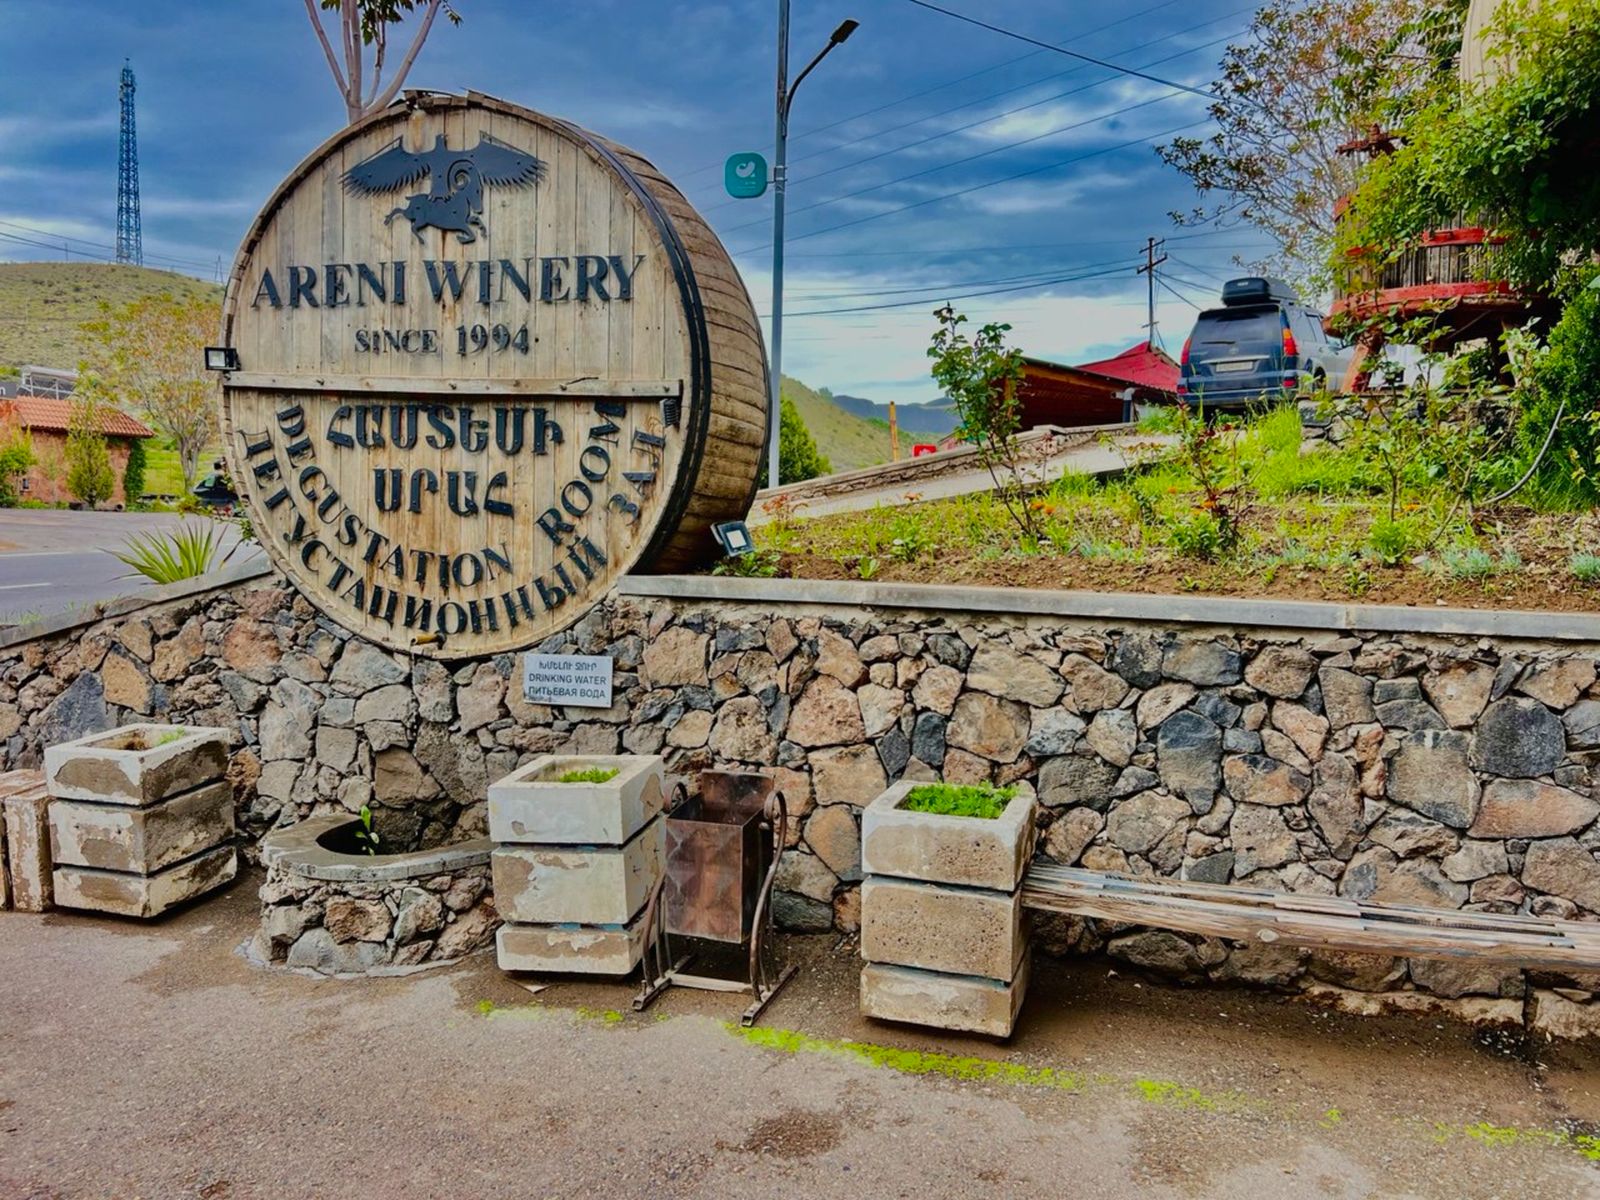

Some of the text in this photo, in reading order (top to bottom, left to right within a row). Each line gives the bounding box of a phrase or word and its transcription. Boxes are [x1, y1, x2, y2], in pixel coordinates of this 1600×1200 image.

[251, 254, 646, 309] ARENI WINERY
[354, 324, 529, 356] SINCE 1994
[326, 403, 564, 456] ՀԱՄՏԵՍԻ
[276, 400, 628, 588] DEGUSTATION ROOM
[373, 467, 515, 518] ՍՐԱՀ
[235, 424, 667, 635] ДЕГУСТАЦИОННЫЙ ЗАЛ
[528, 673, 607, 685] DRINKING WATER
[528, 686, 606, 699] ПИТЬЕВАЯ ВОДА
